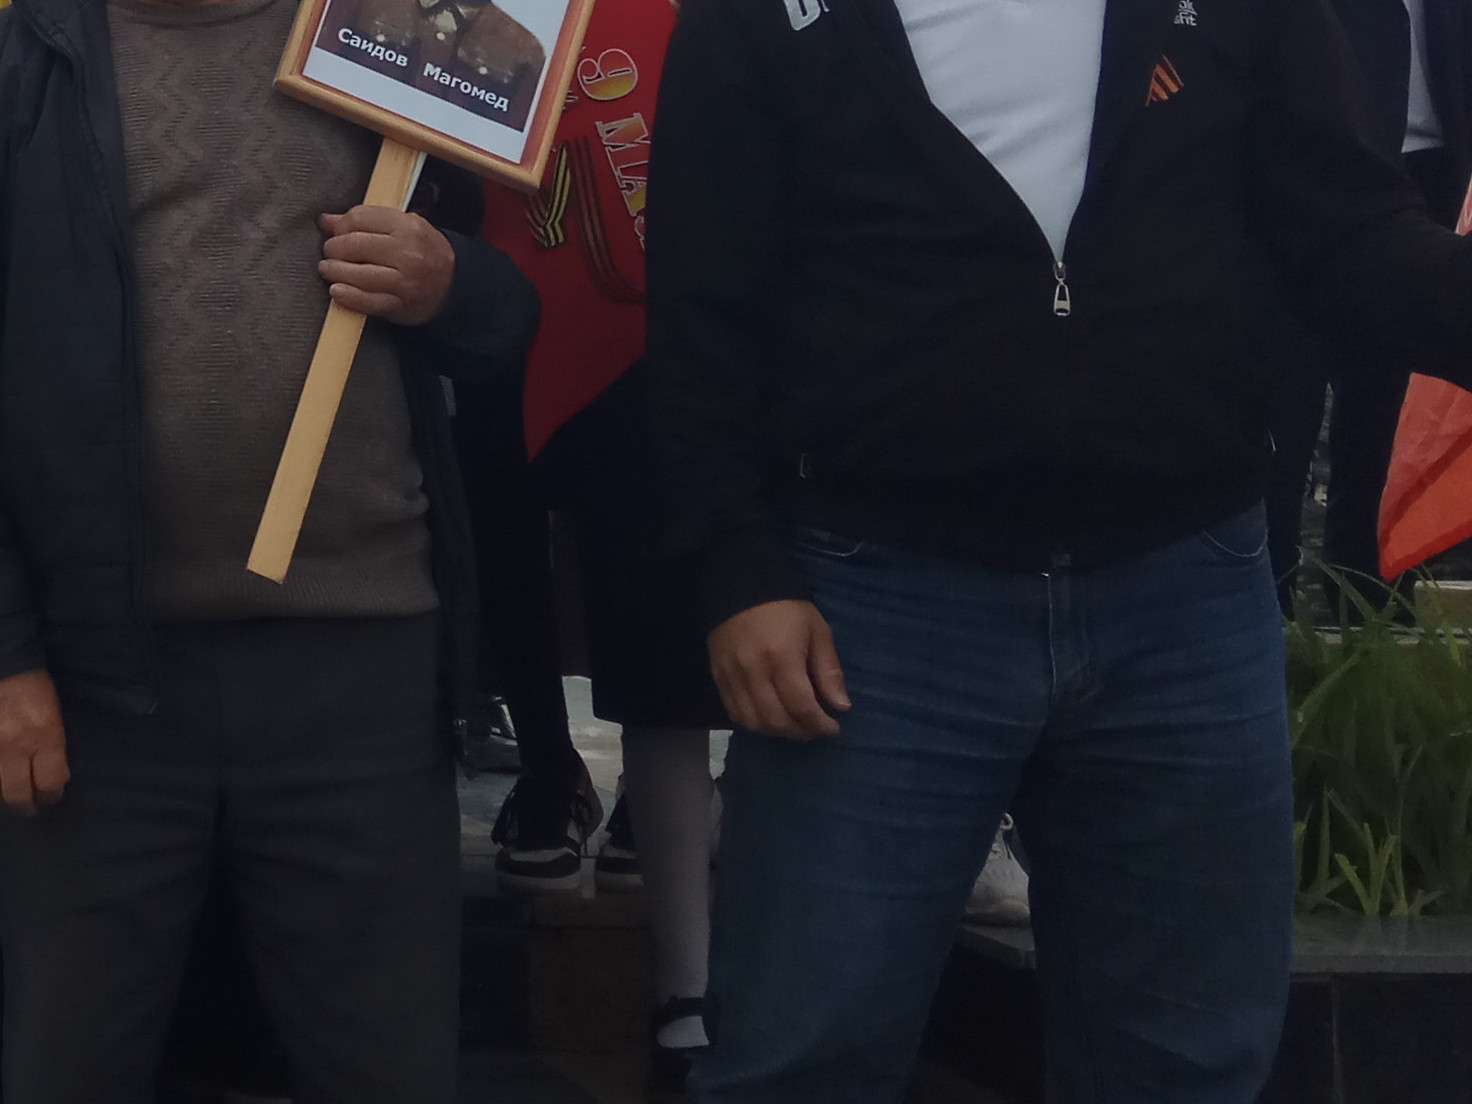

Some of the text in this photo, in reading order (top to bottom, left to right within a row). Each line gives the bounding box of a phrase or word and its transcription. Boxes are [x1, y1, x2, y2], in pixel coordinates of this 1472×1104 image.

[337, 27, 509, 113] Саидов Магомед
[577, 47, 639, 101] 9
